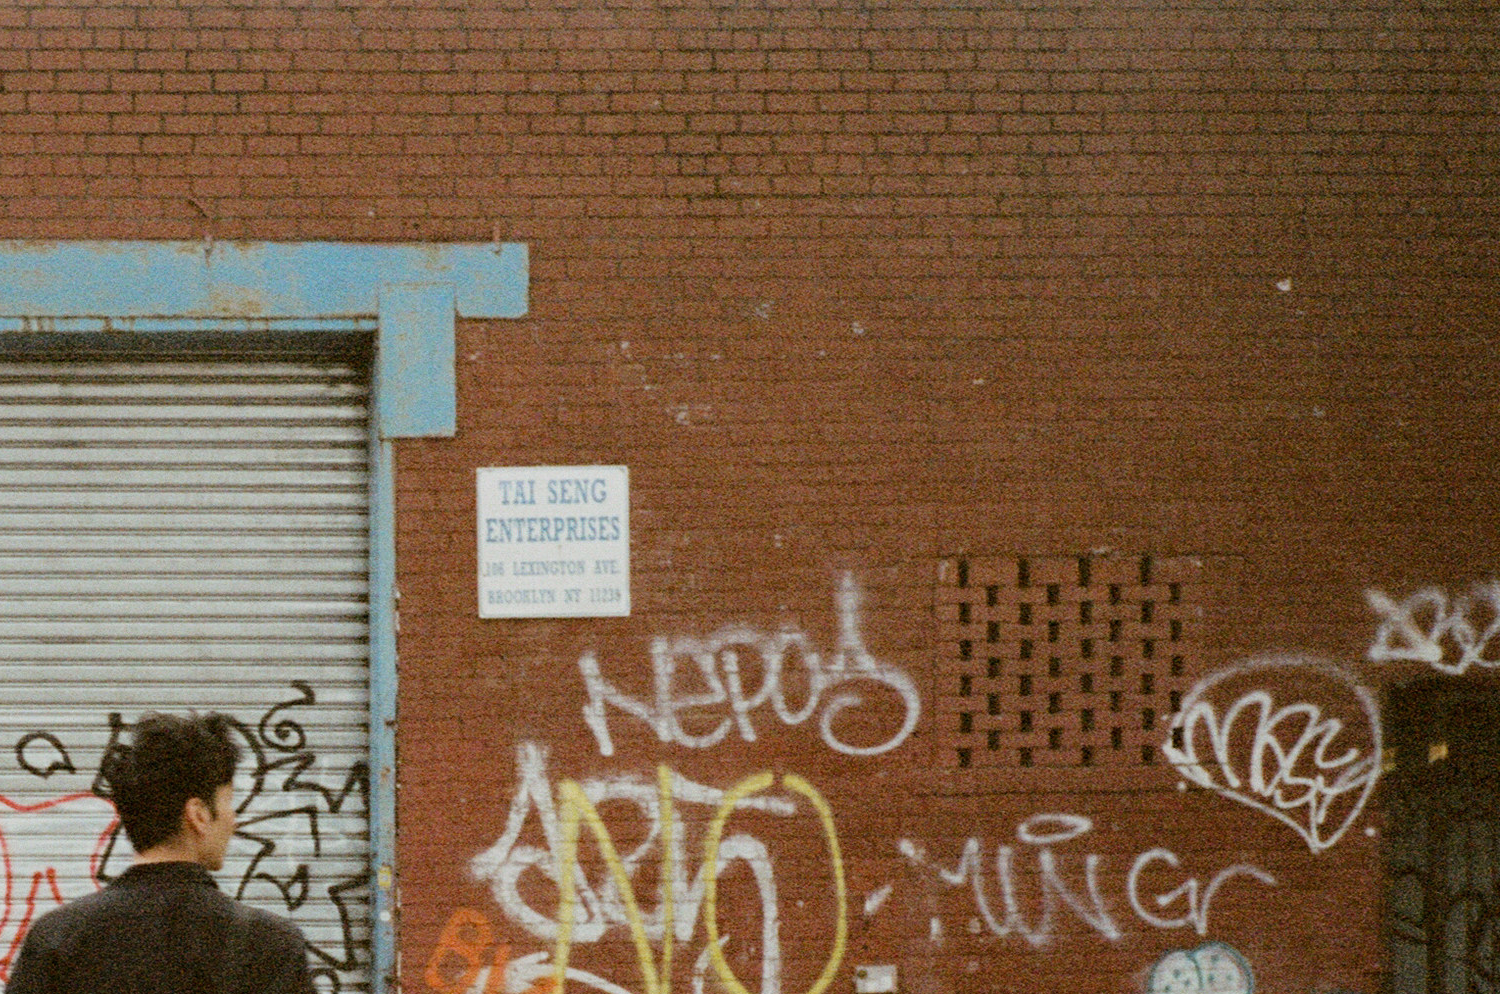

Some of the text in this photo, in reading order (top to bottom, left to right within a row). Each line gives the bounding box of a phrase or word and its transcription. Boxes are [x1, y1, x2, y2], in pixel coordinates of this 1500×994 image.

[499, 478, 607, 505] TAI SENG
[485, 516, 620, 542] ENTERPRISES
[512, 560, 585, 576] LEXINGTON
[487, 588, 555, 604] BROOKLYN
[564, 587, 581, 603] NY
